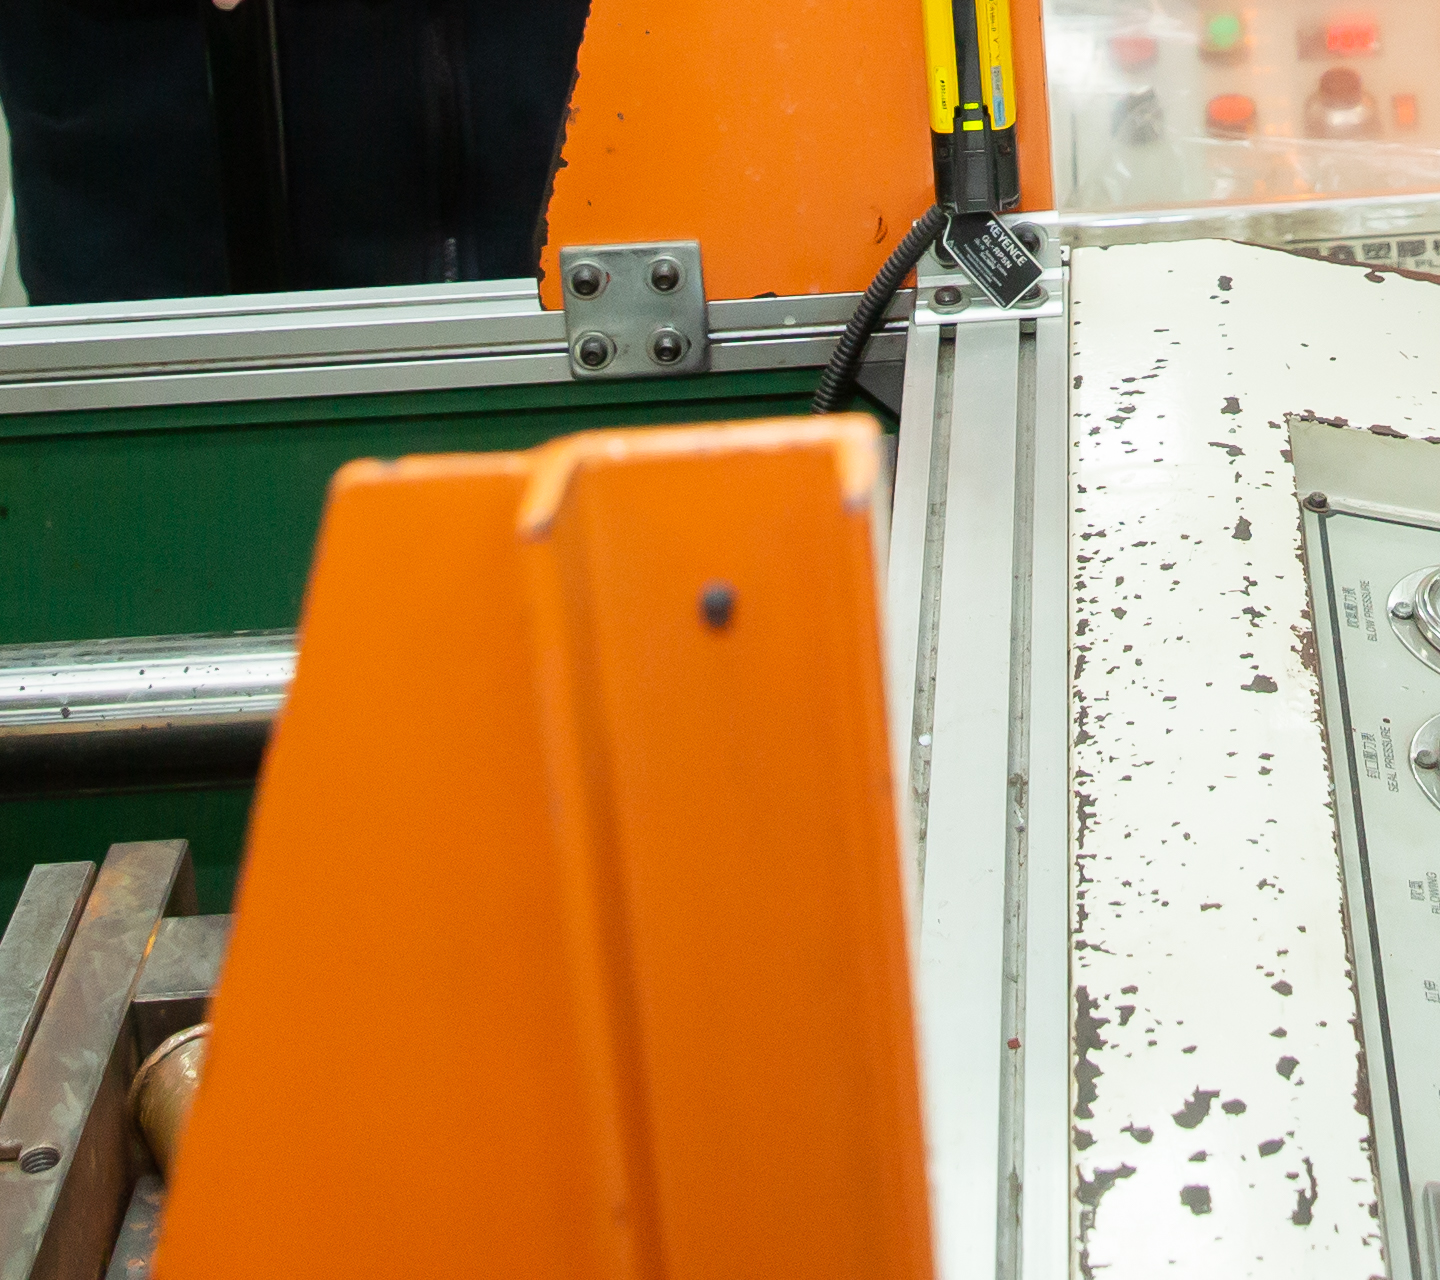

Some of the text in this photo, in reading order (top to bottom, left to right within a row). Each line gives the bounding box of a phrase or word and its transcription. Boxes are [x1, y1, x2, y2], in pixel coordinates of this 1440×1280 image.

[985, 220, 1028, 267] KEYENCE
[1360, 580, 1377, 642] BLOW PRESSURE
[1380, 726, 1399, 793] SEAL PRESSURE
